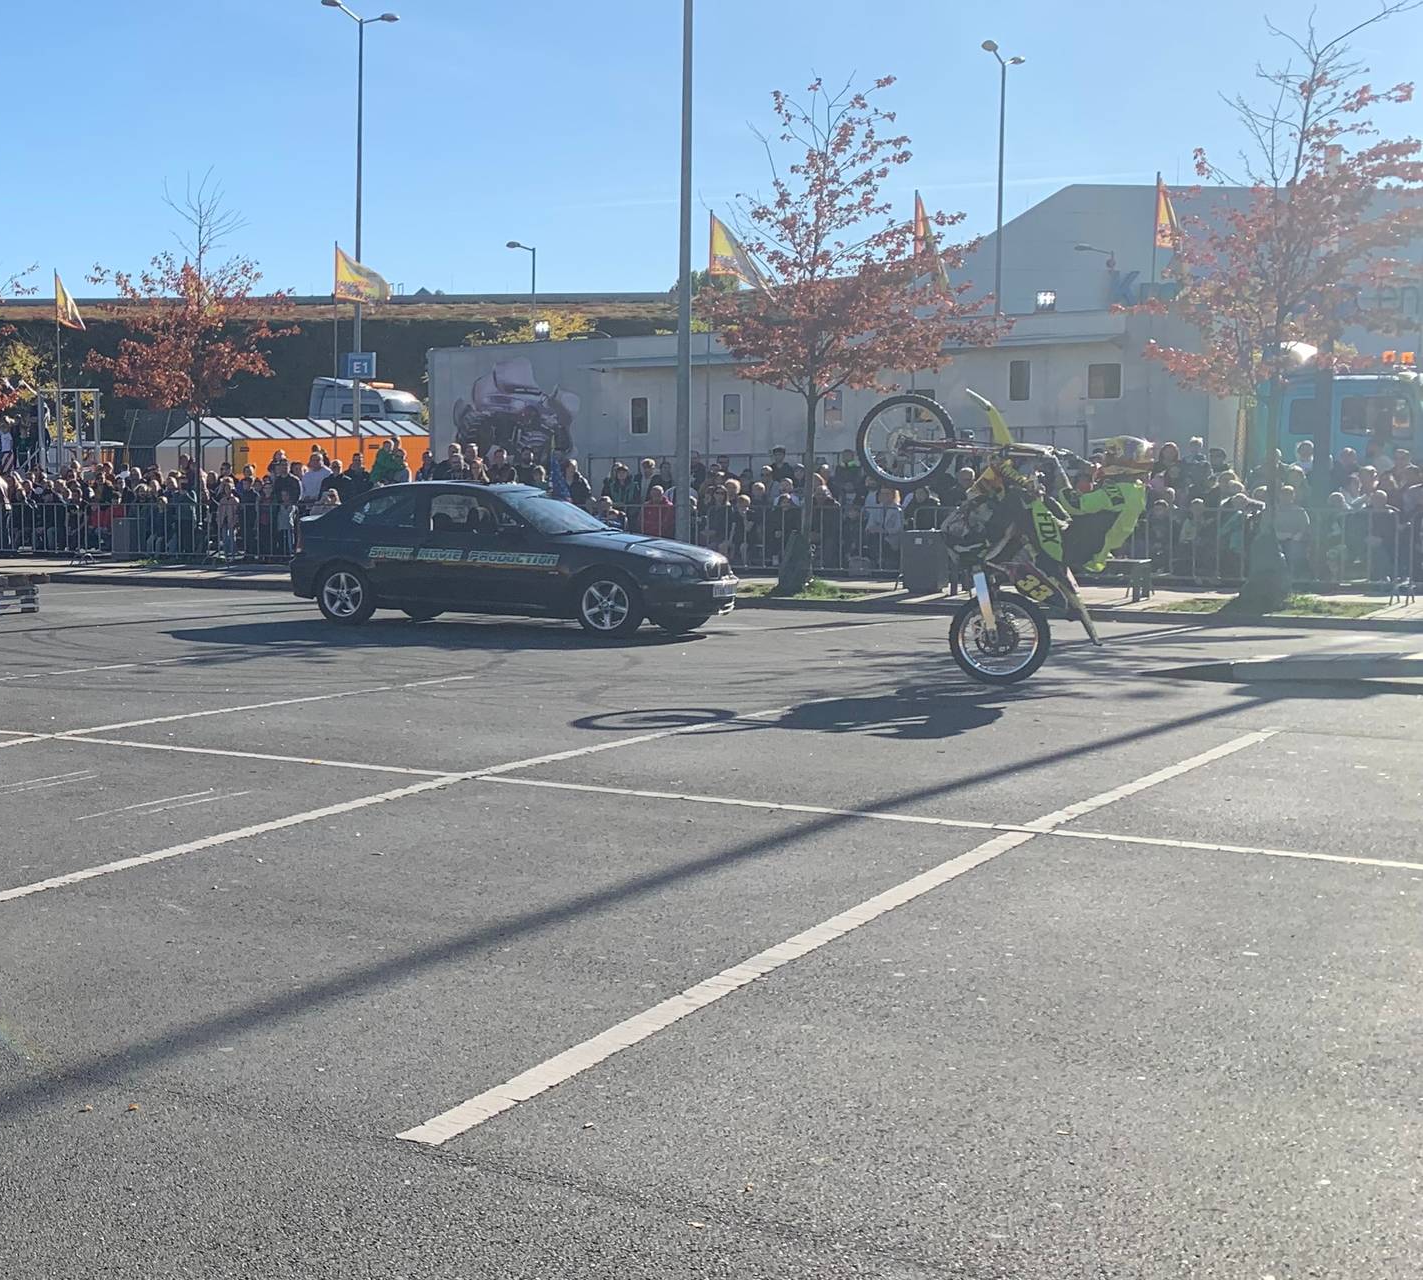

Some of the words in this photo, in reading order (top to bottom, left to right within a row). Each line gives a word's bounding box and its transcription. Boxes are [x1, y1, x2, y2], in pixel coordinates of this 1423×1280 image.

[353, 361, 369, 374] E1
[1037, 511, 1060, 544] FOX
[368, 546, 414, 558] STUNT
[416, 548, 463, 561] MOVIE
[467, 551, 560, 566] PRODUCTION
[1016, 574, 1054, 601] 33
